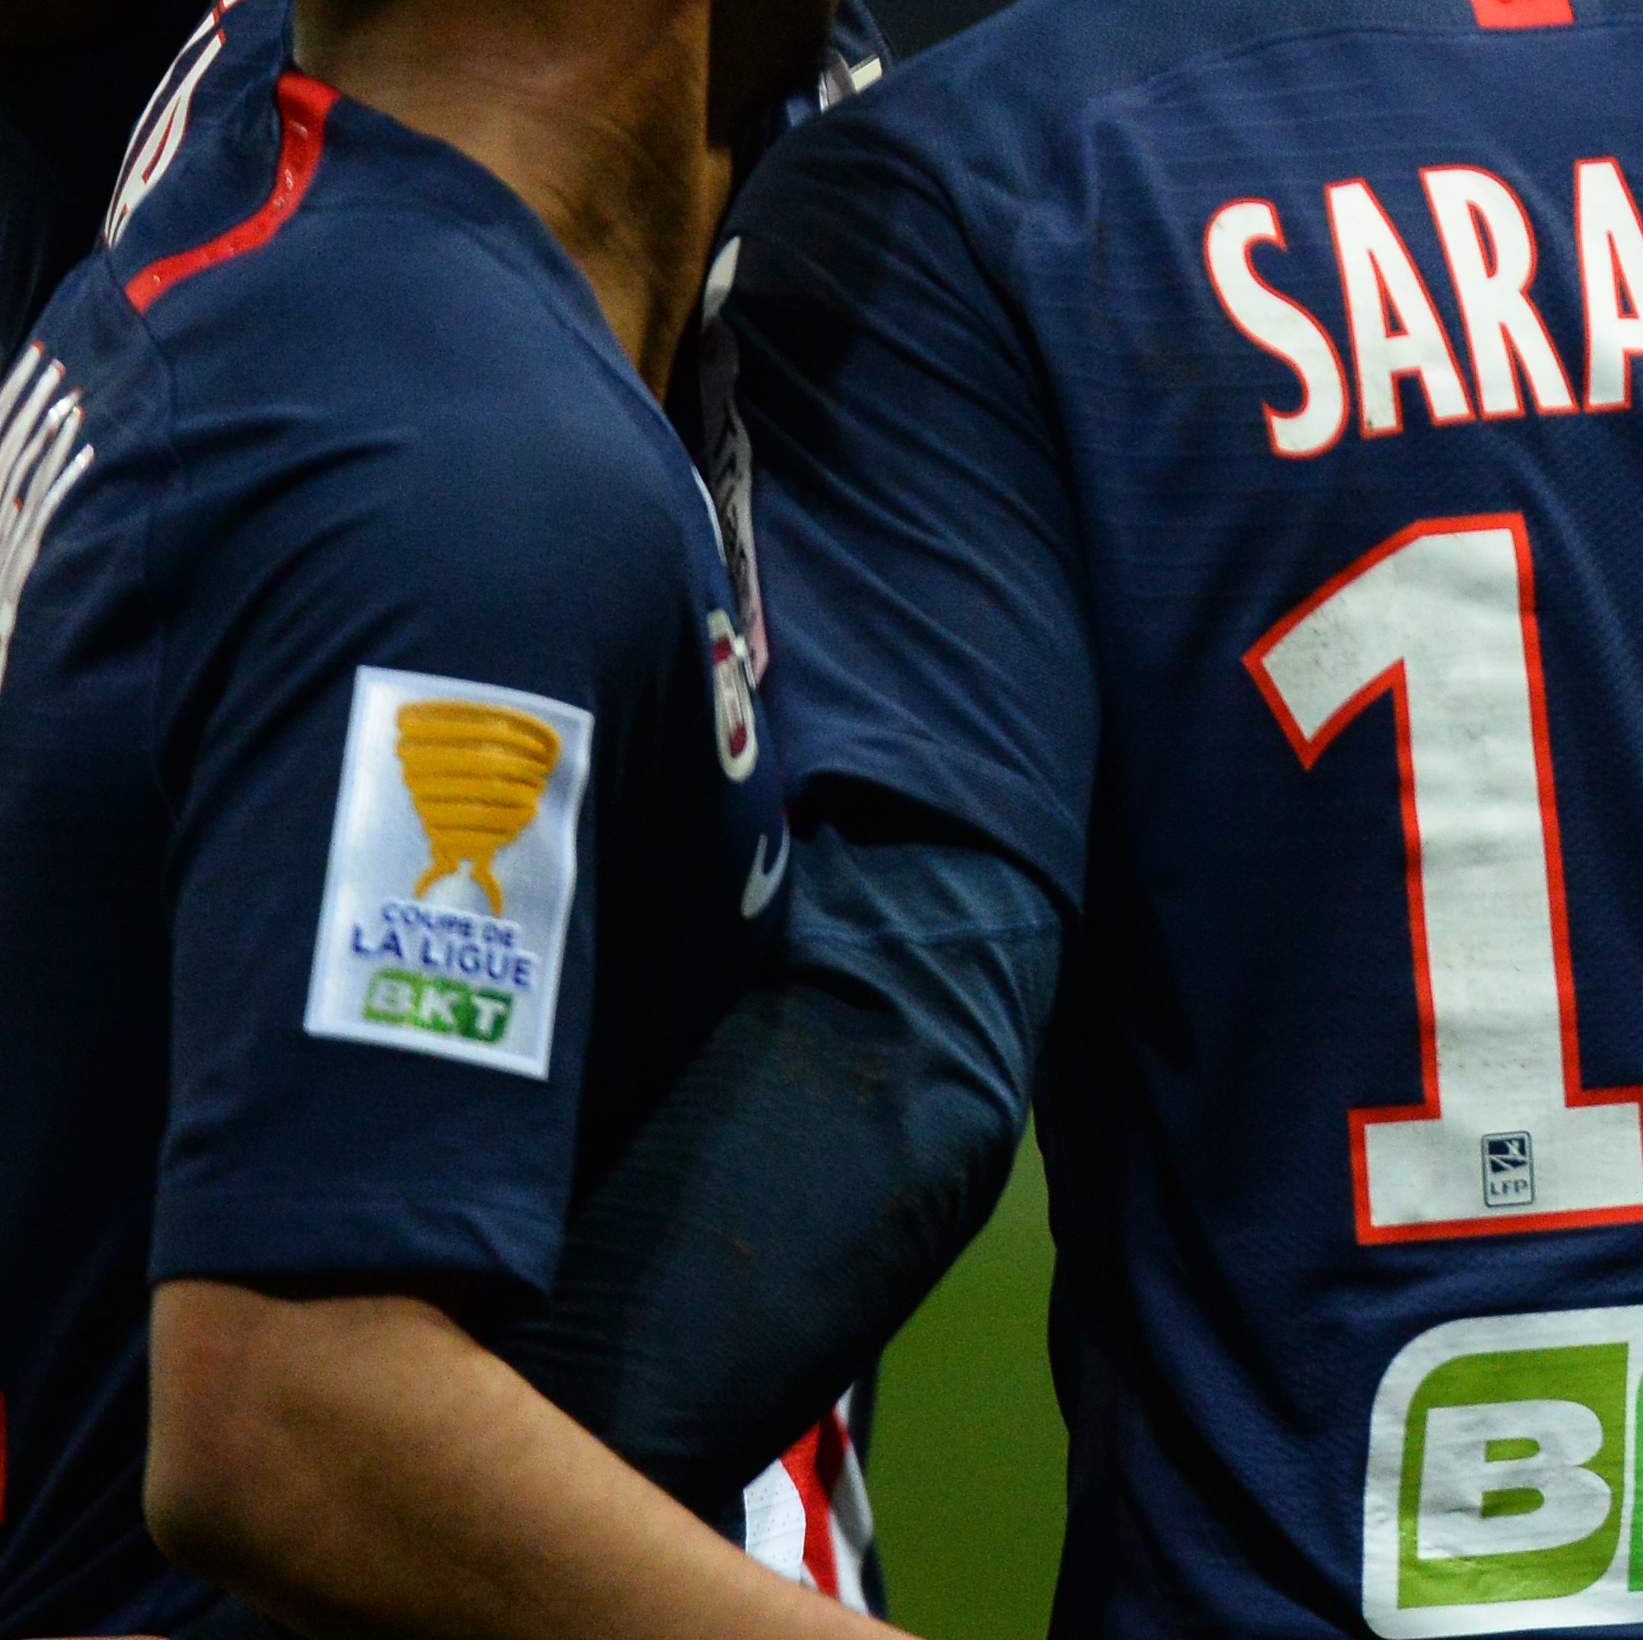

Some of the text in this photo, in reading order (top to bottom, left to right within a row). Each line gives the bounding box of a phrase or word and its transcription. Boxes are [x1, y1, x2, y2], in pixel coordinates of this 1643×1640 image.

[382, 900, 516, 947] COUPE DE
[352, 923, 532, 988] LA LIGUE
[376, 977, 507, 1038] BKT
[1490, 1179, 1528, 1196] LFP
